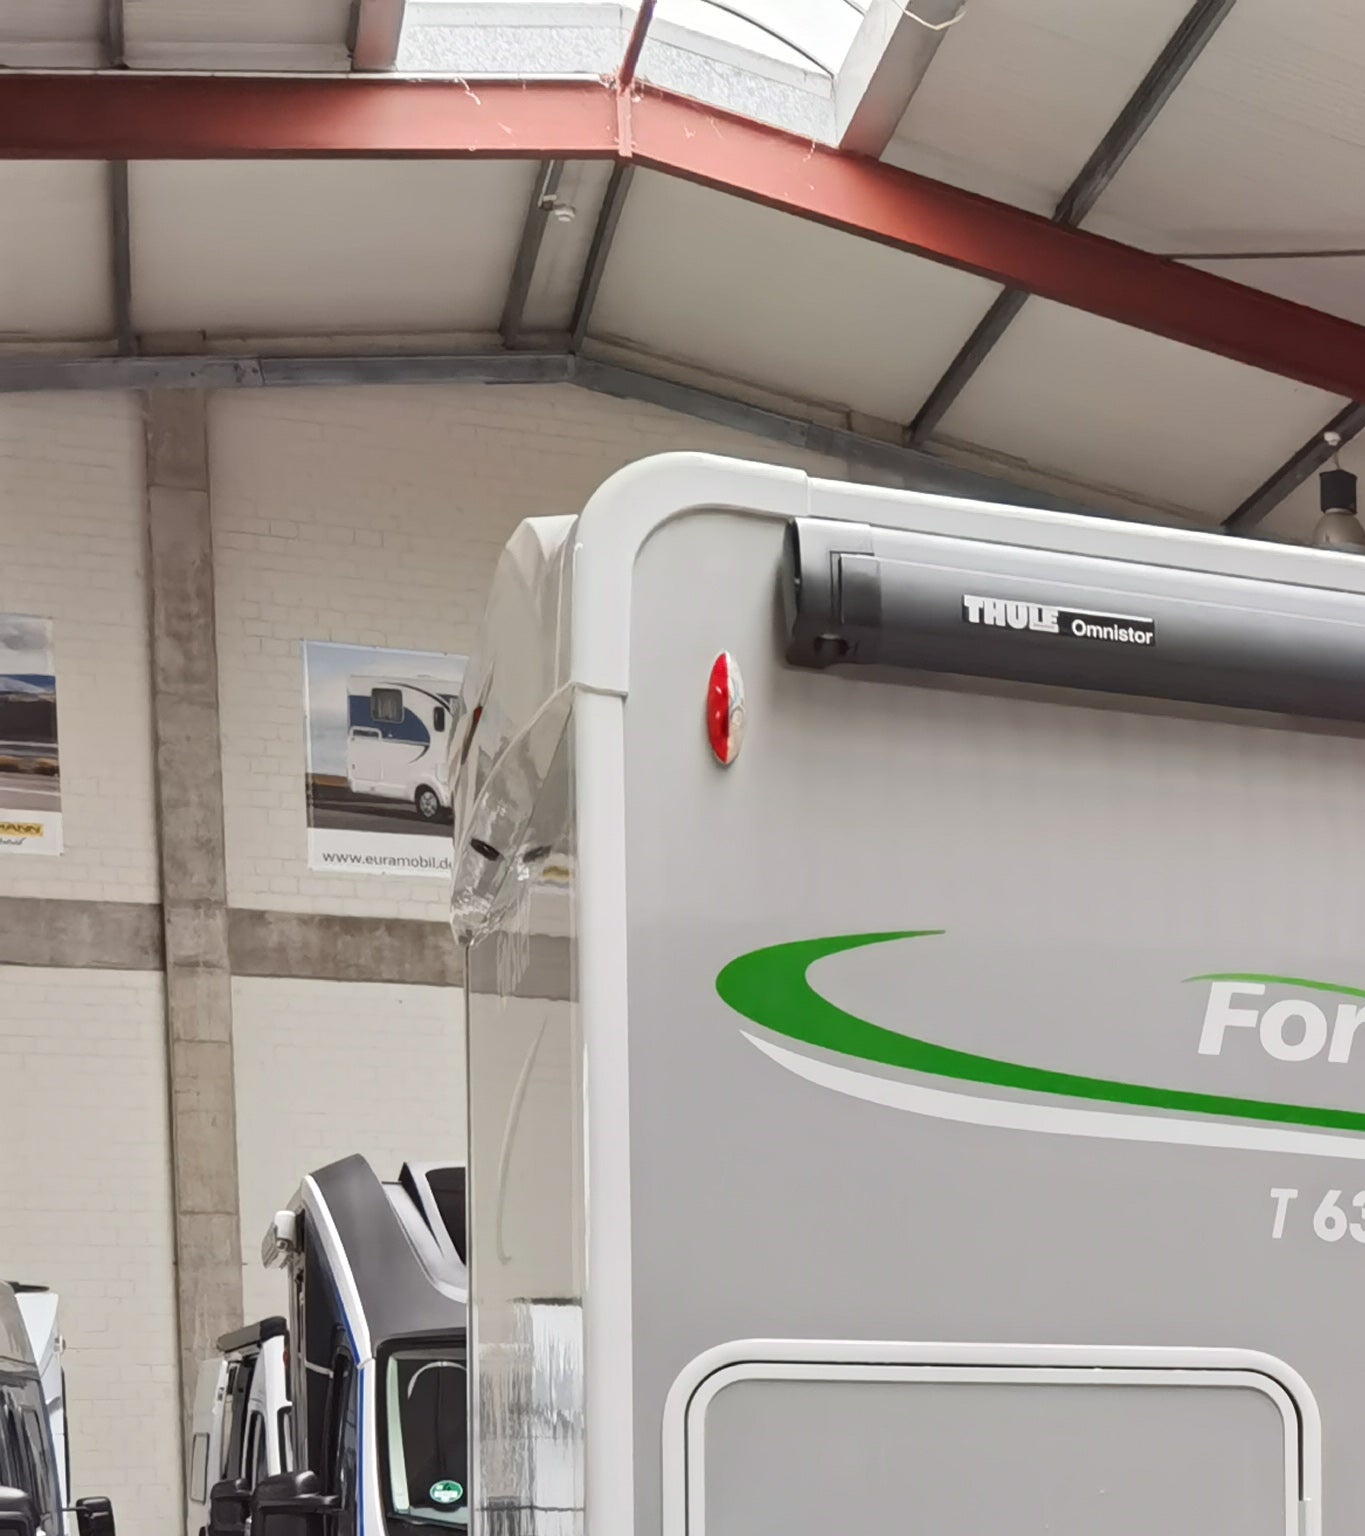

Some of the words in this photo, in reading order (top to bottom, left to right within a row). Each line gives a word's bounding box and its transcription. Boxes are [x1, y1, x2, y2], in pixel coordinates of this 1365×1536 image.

[964, 594, 1060, 633] THULE
[1071, 619, 1153, 645] Omnistor
[1270, 1187, 1298, 1239] T
